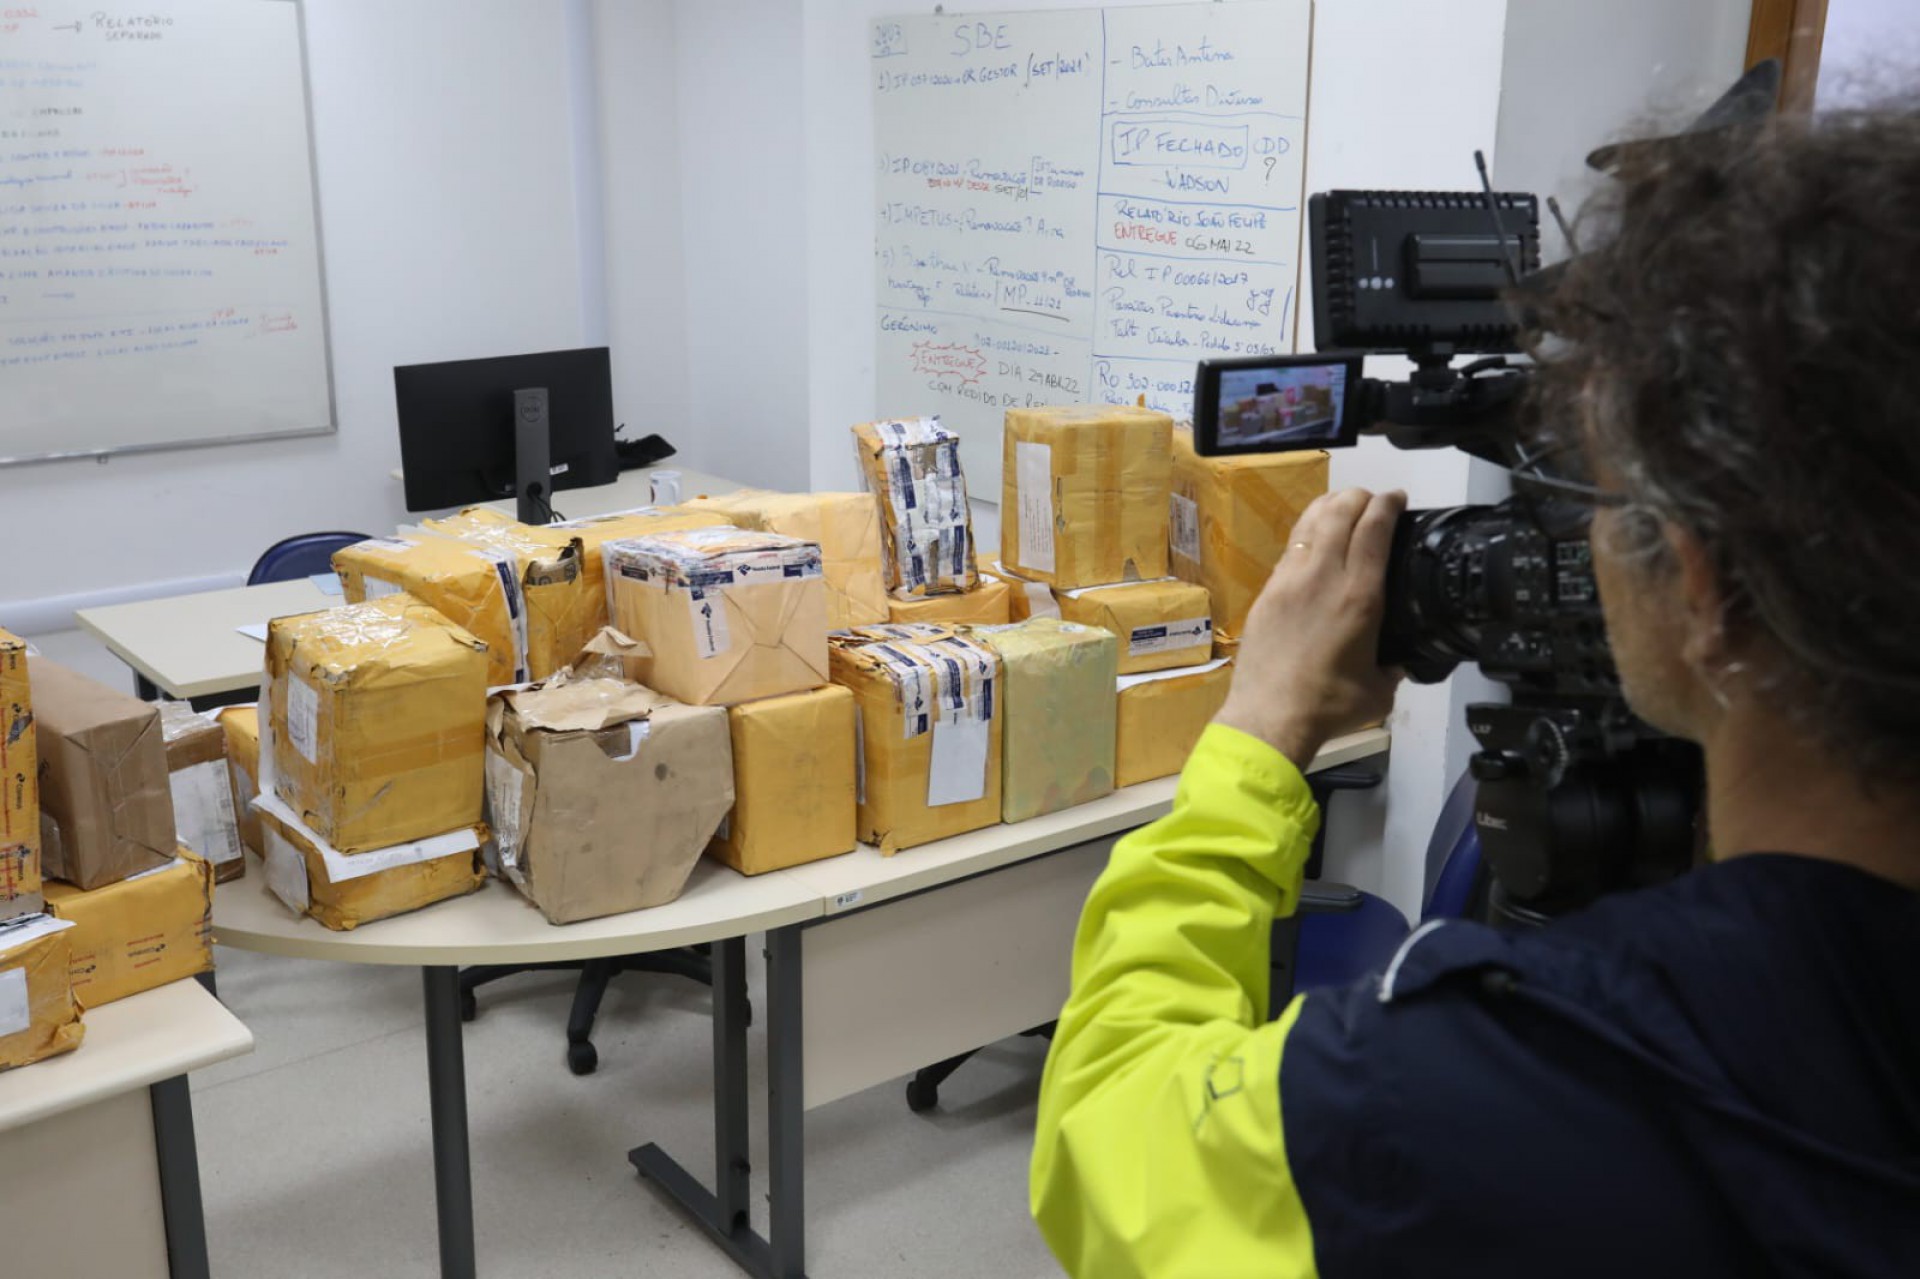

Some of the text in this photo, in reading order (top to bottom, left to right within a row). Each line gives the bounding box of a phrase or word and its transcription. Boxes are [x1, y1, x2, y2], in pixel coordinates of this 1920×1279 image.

[950, 22, 1012, 56] SBE
[1119, 128, 1151, 156] IP
[1155, 131, 1243, 158] FECHADO
[1114, 221, 1177, 246] ENTREGUE
[1235, 239, 1256, 255] 22
[1004, 285, 1027, 305] MP
[998, 361, 1022, 381] DIA
